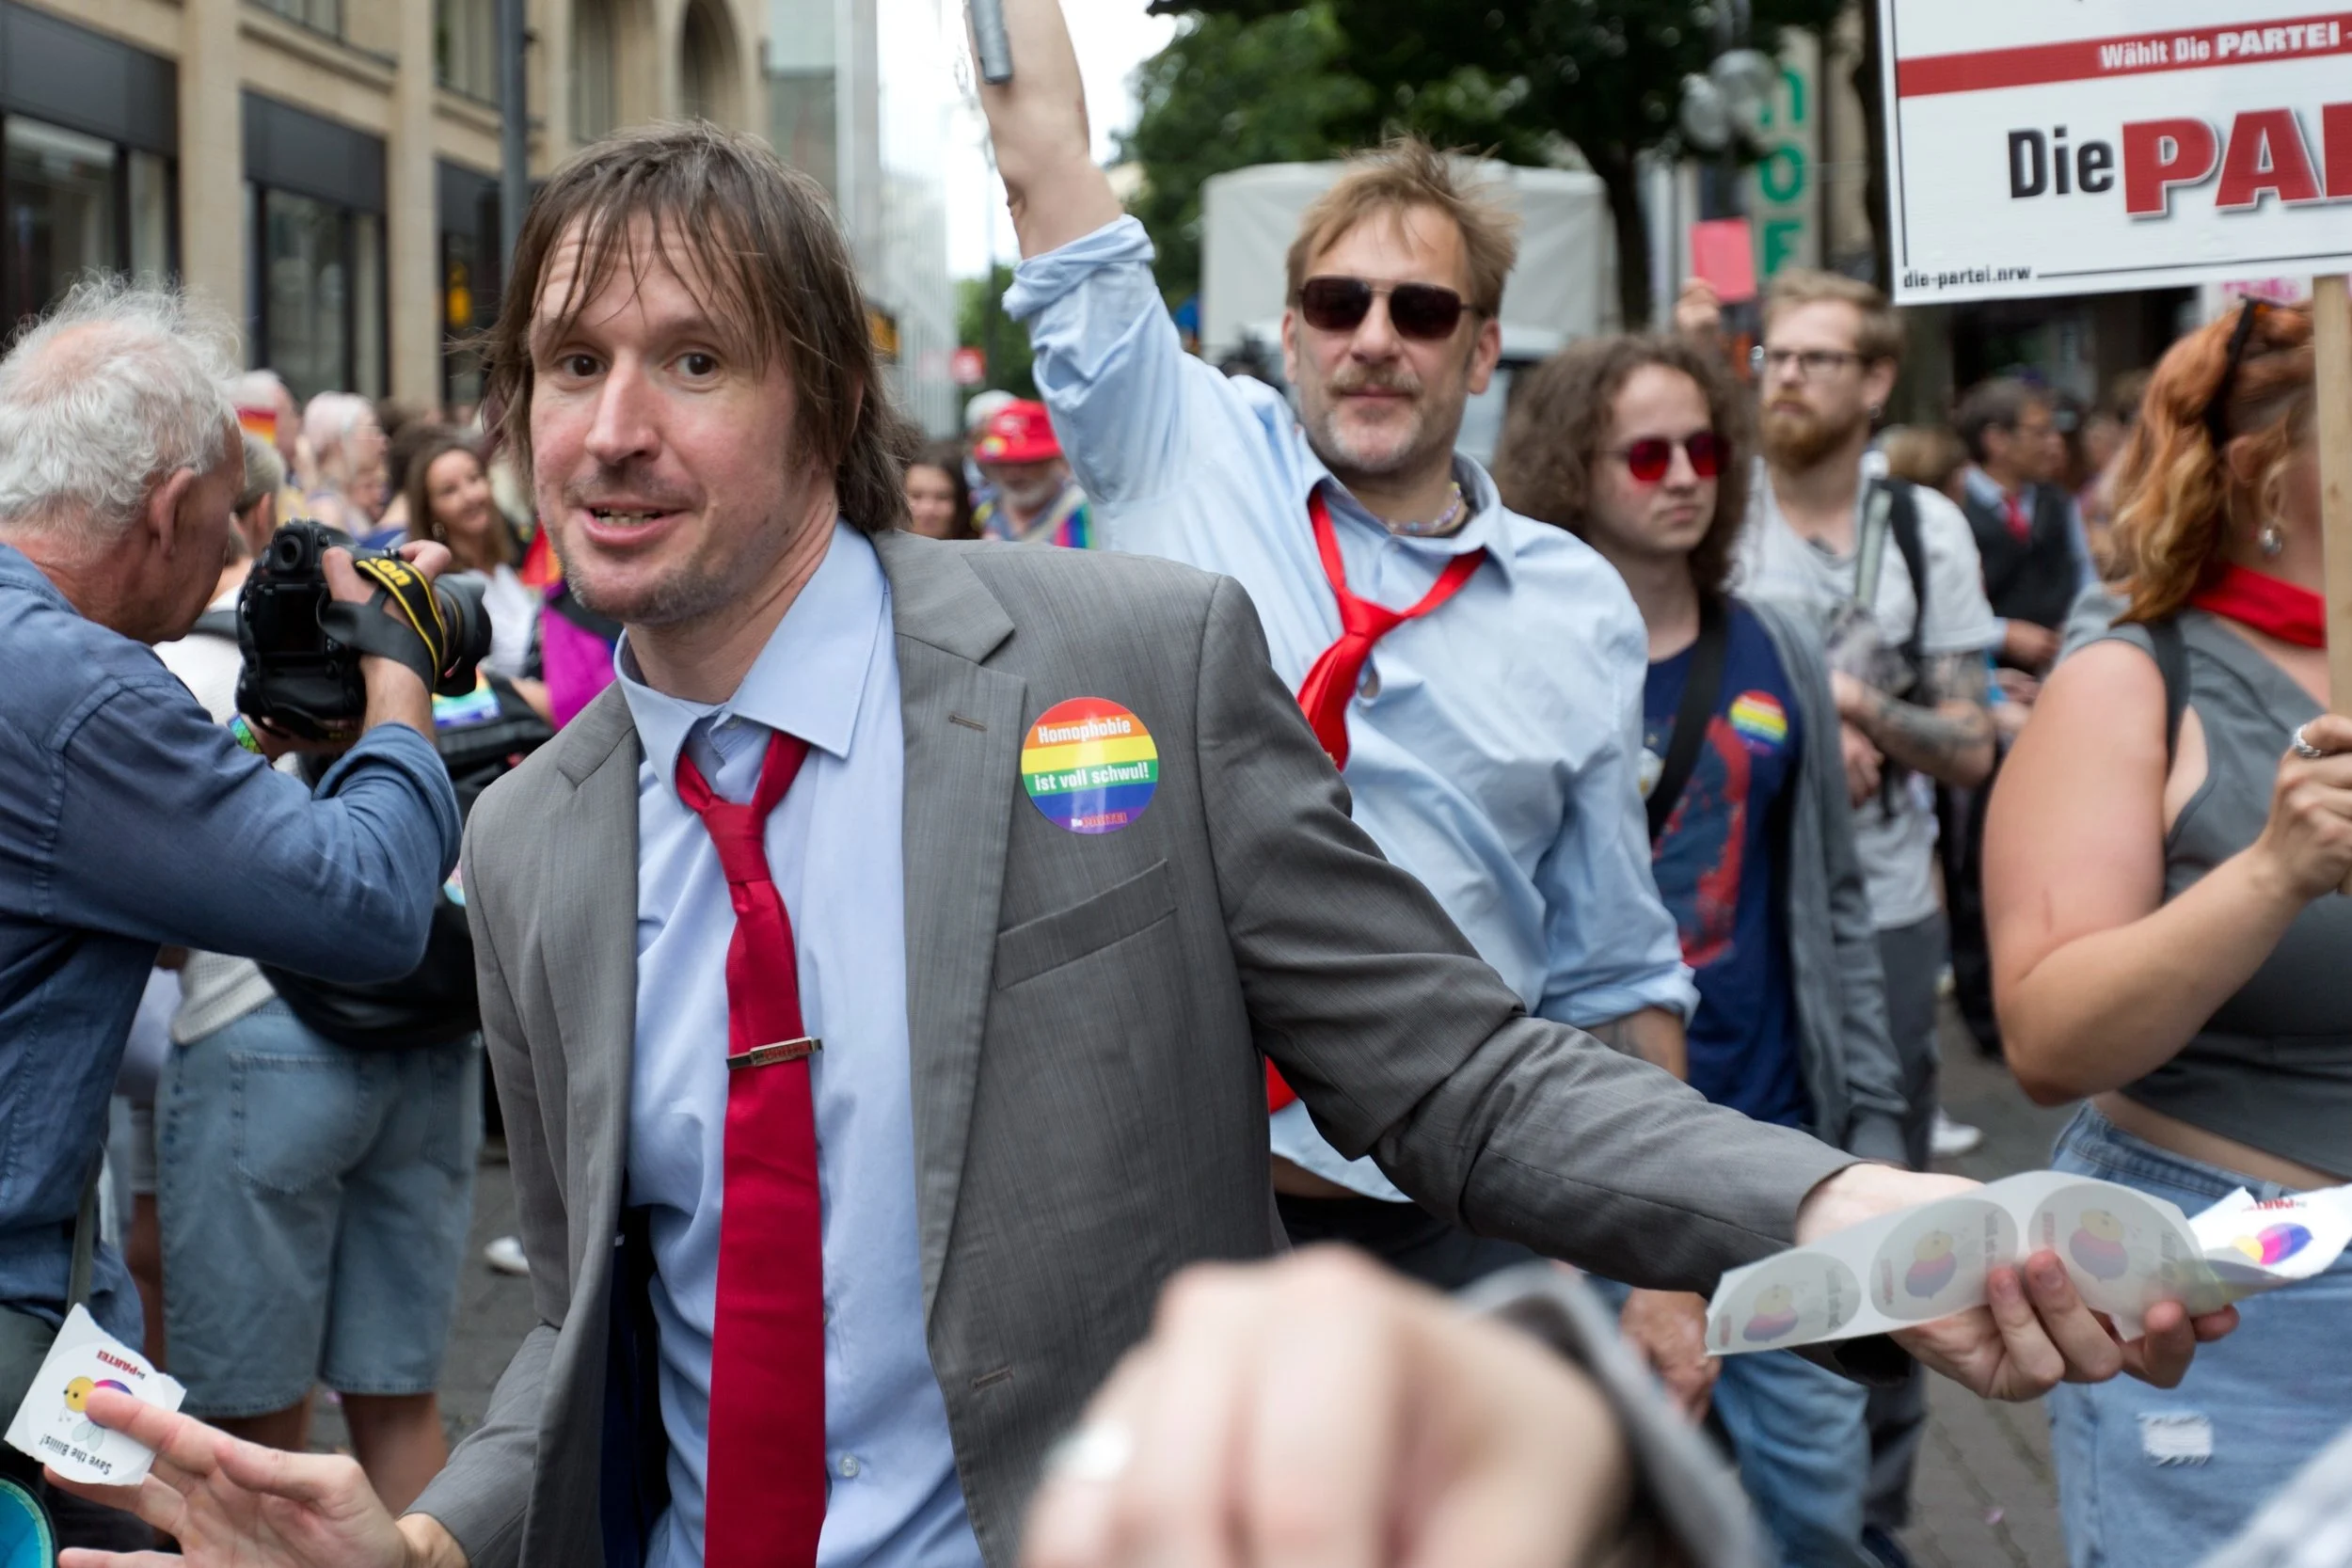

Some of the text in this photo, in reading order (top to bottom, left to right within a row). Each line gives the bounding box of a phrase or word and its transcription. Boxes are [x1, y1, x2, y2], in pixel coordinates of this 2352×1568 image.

[2100, 21, 2341, 70] Wählt Die PARTEI
[1903, 264, 2032, 290] die-partei.nrw
[1037, 718, 1132, 744] Homophobie
[1035, 762, 1150, 791] ist voll schwul!
[71, 1446, 87, 1464] the
[88, 1455, 112, 1475] Save
